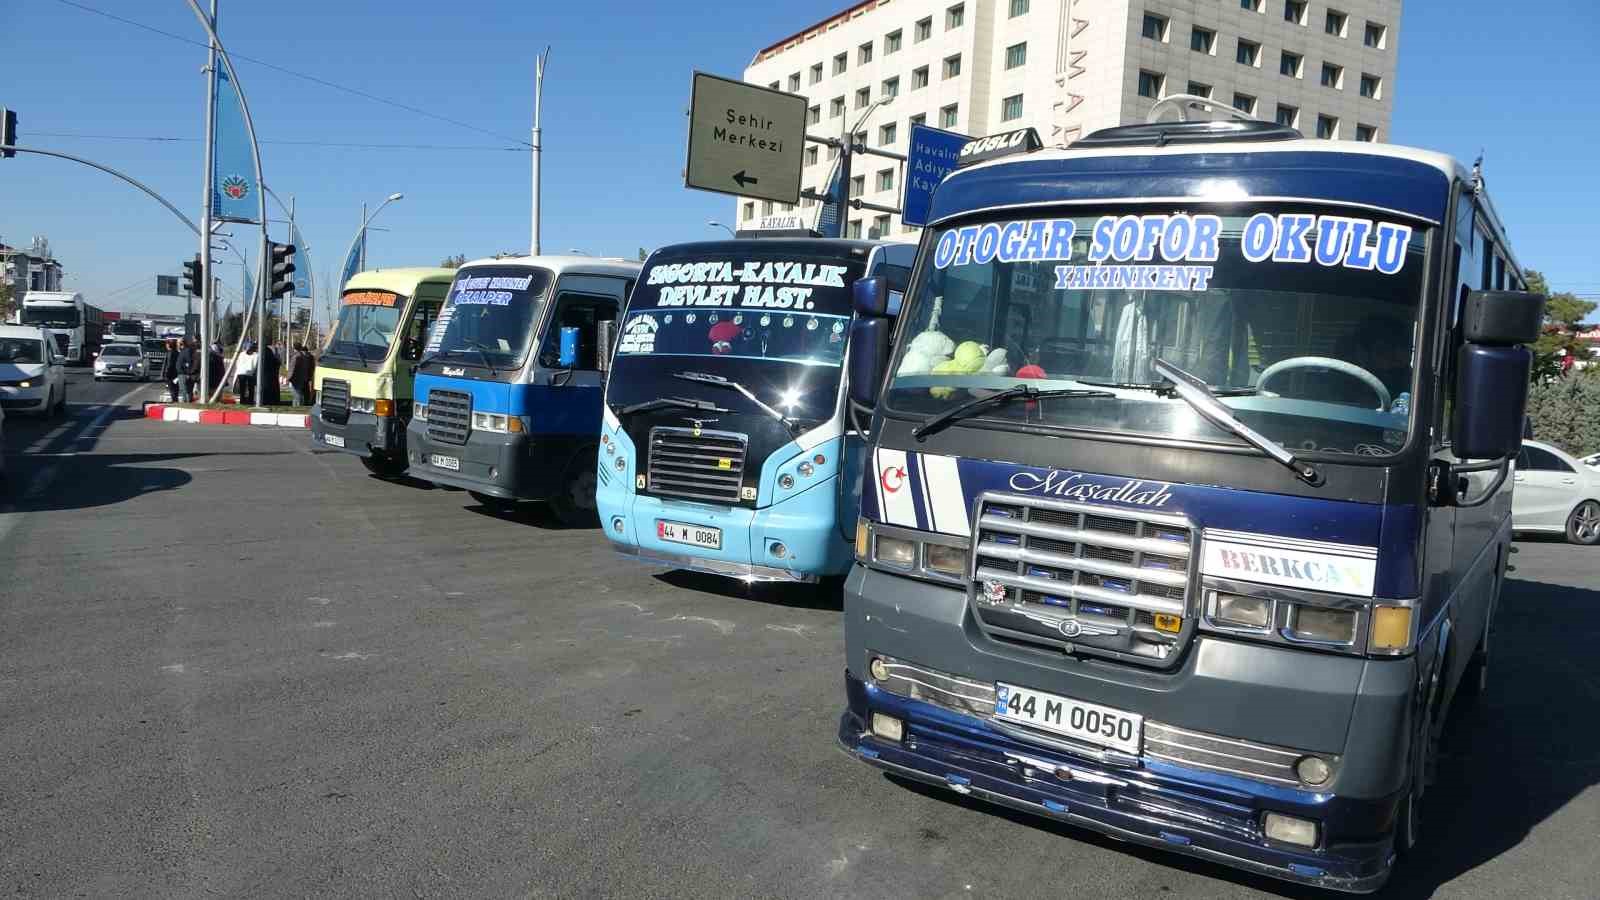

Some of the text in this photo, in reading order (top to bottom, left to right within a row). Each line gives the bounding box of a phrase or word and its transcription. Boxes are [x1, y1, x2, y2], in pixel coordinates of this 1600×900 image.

[726, 108, 773, 129] Şehir
[713, 126, 783, 152] Merkezi
[934, 219, 1076, 269] OTOGAR
[1241, 213, 1412, 275] OKULU
[1054, 265, 1213, 291] YAKINKENT
[657, 285, 815, 310] DEVLET HAST.
[1009, 469, 1172, 507] Maşallah
[664, 523, 718, 545] 44 M 0084
[1008, 692, 1036, 718] 44
[1045, 700, 1062, 725] M
[1070, 706, 1133, 741] 0050
